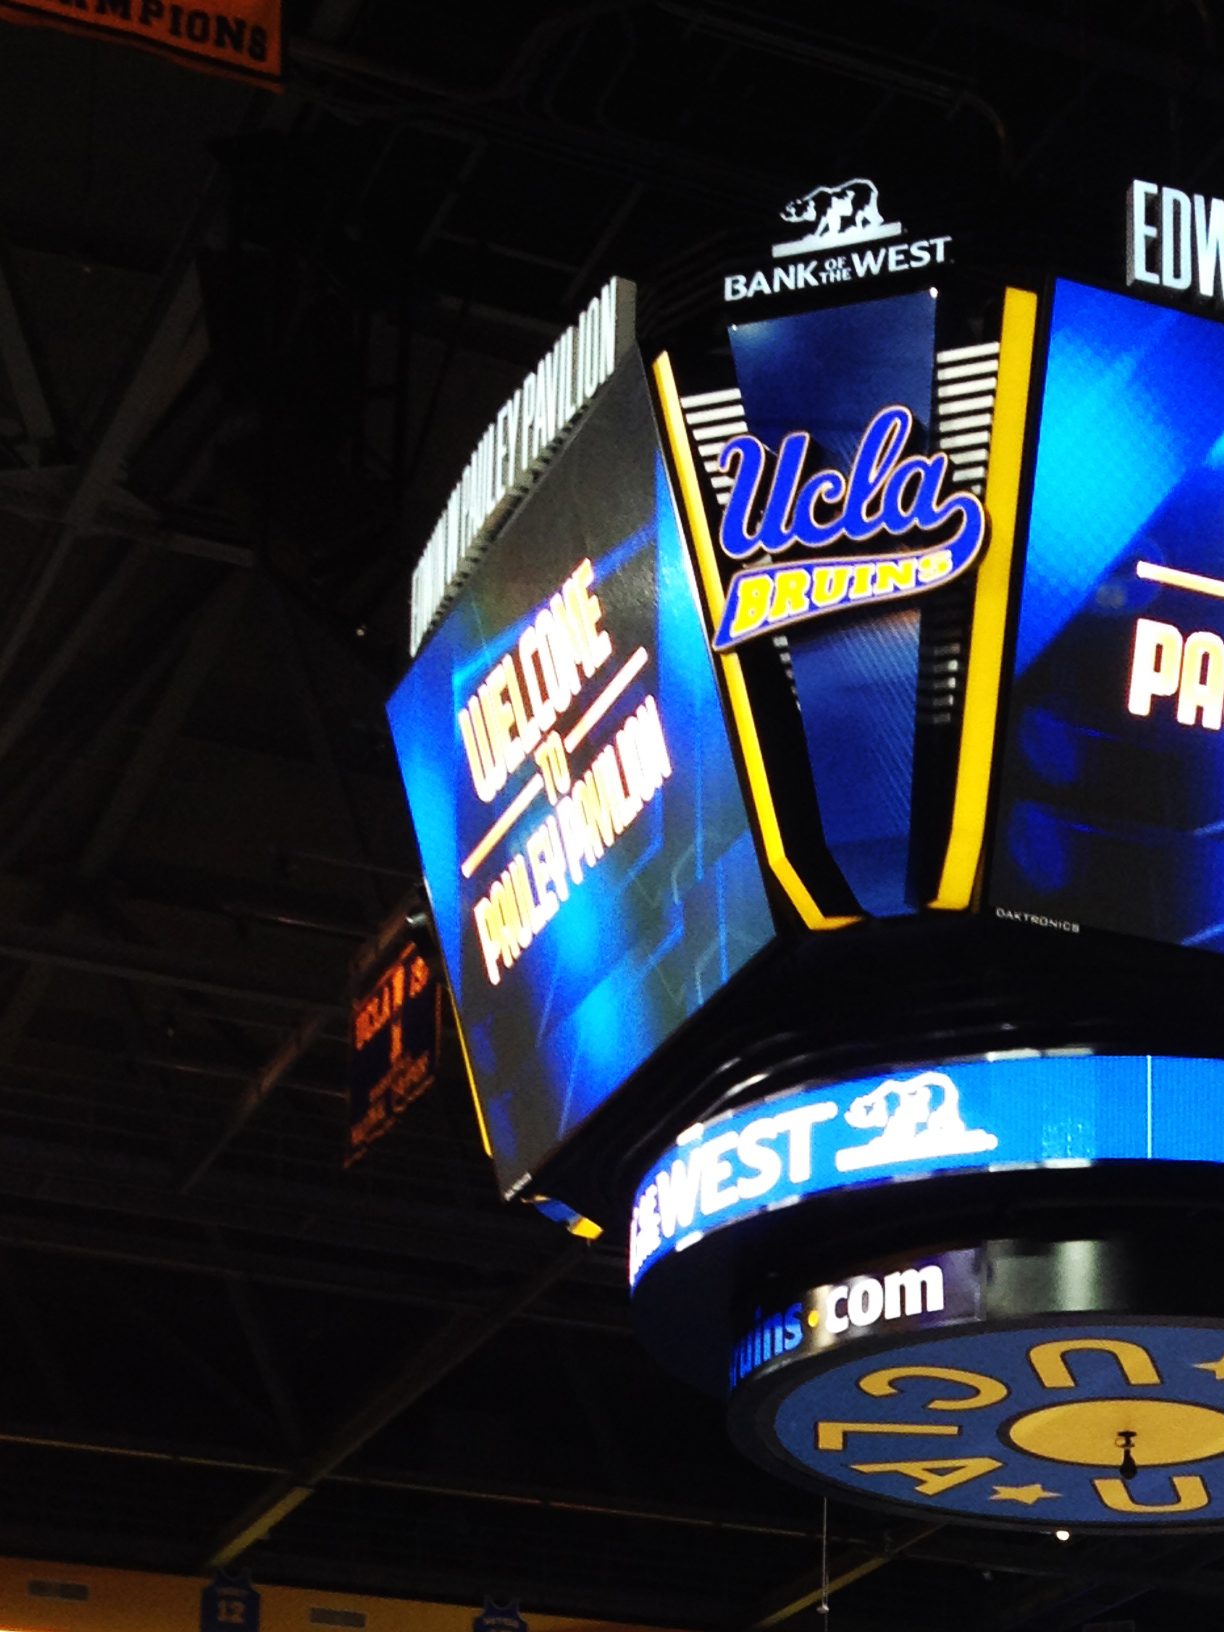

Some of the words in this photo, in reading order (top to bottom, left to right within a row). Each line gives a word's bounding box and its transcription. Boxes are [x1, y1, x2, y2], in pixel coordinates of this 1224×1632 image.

[724, 261, 819, 301] BANK
[819, 265, 852, 283] THE
[823, 256, 848, 272] OF
[851, 236, 952, 279] WEST
[521, 276, 618, 472] PAVILION
[730, 548, 954, 638] BRUINS
[458, 557, 612, 802] WELCOME
[533, 730, 570, 806] TO
[556, 694, 672, 885] PAVILION
[473, 814, 569, 986] PAULEY
[656, 1101, 838, 1238] WEST
